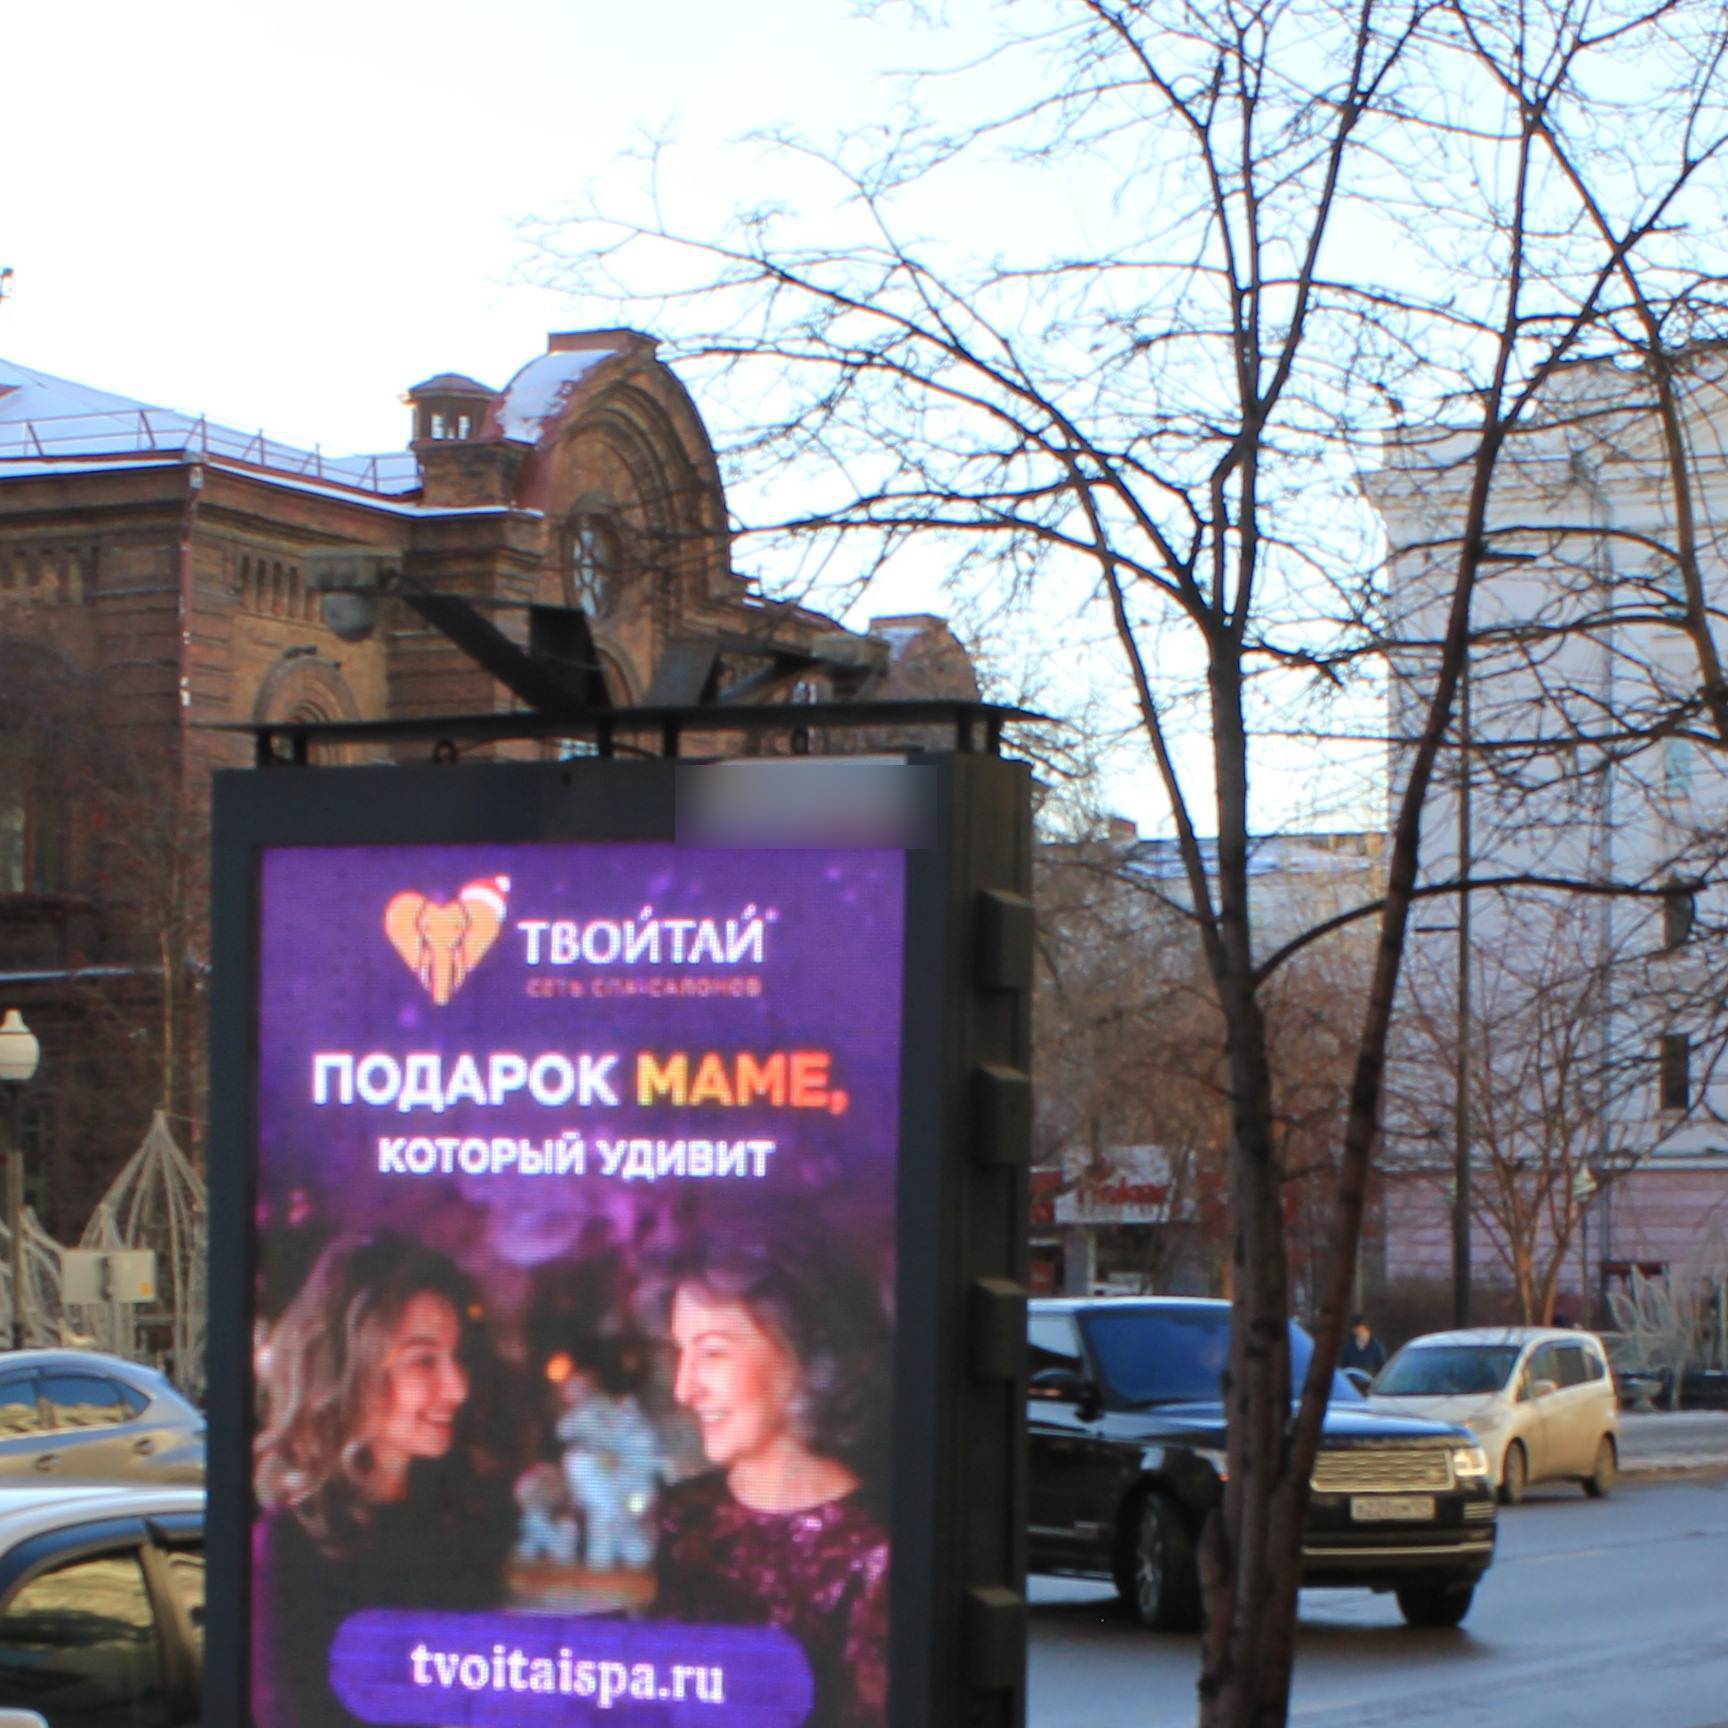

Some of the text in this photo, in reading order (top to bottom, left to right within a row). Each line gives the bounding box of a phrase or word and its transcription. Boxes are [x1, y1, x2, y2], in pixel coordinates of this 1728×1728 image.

[312, 1051, 850, 1115] ПОДАРОК МАМЕ,
[378, 1133, 776, 1183] КОТОРЫЙ УДИВИТ
[410, 1642, 726, 1708] tvoitaispa.ru
